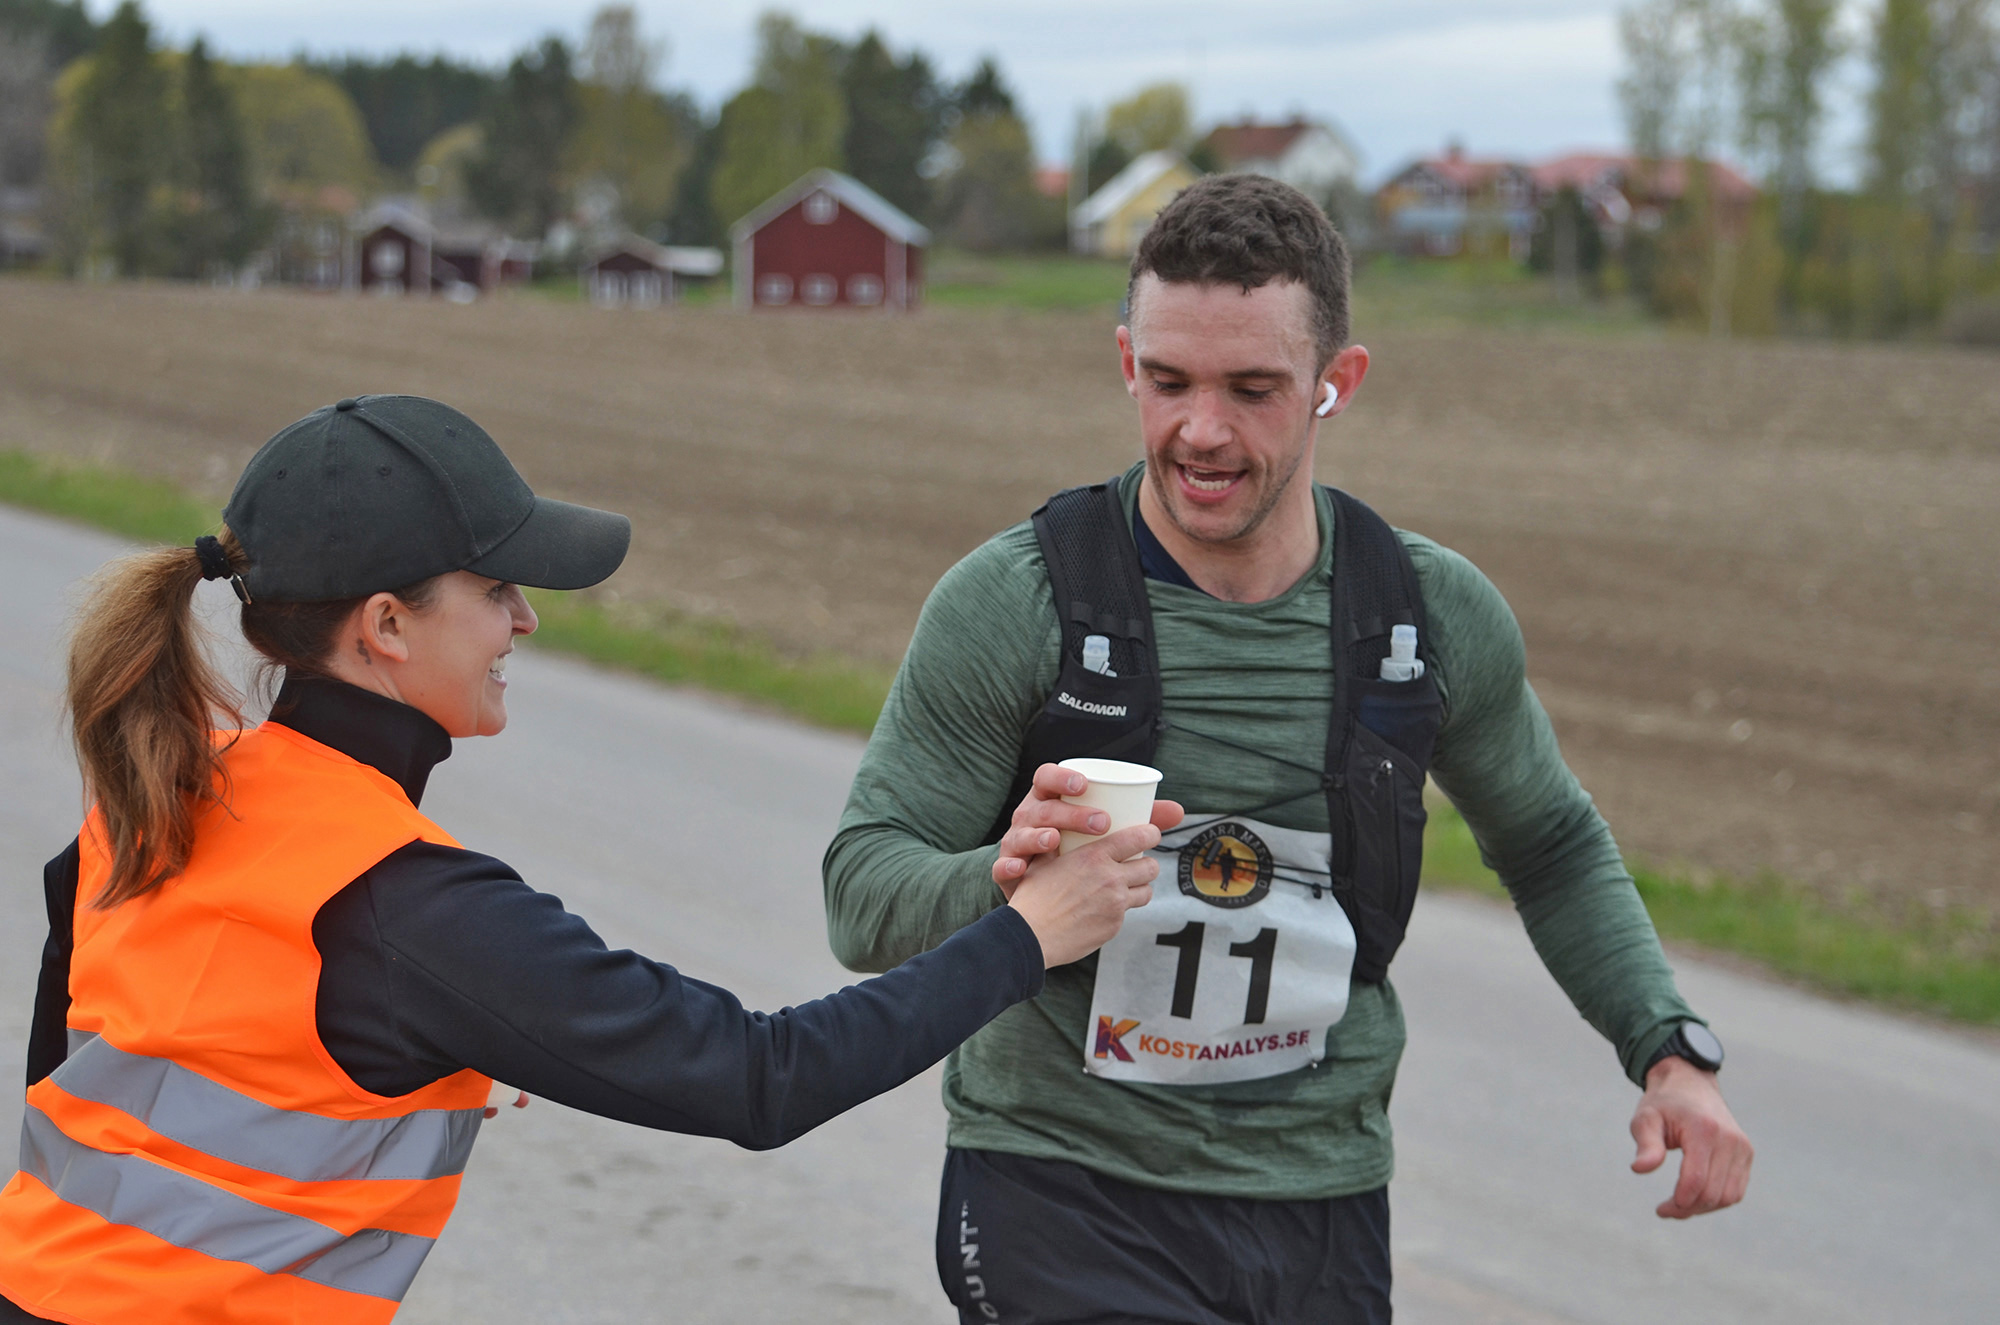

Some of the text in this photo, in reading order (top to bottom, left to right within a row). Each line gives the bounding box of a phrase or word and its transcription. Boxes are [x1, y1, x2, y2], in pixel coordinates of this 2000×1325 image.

[1058, 691, 1127, 716] SALOMON
[1155, 920, 1278, 1025] 11
[1139, 1029, 1311, 1061] KOSTANALYS.SE
